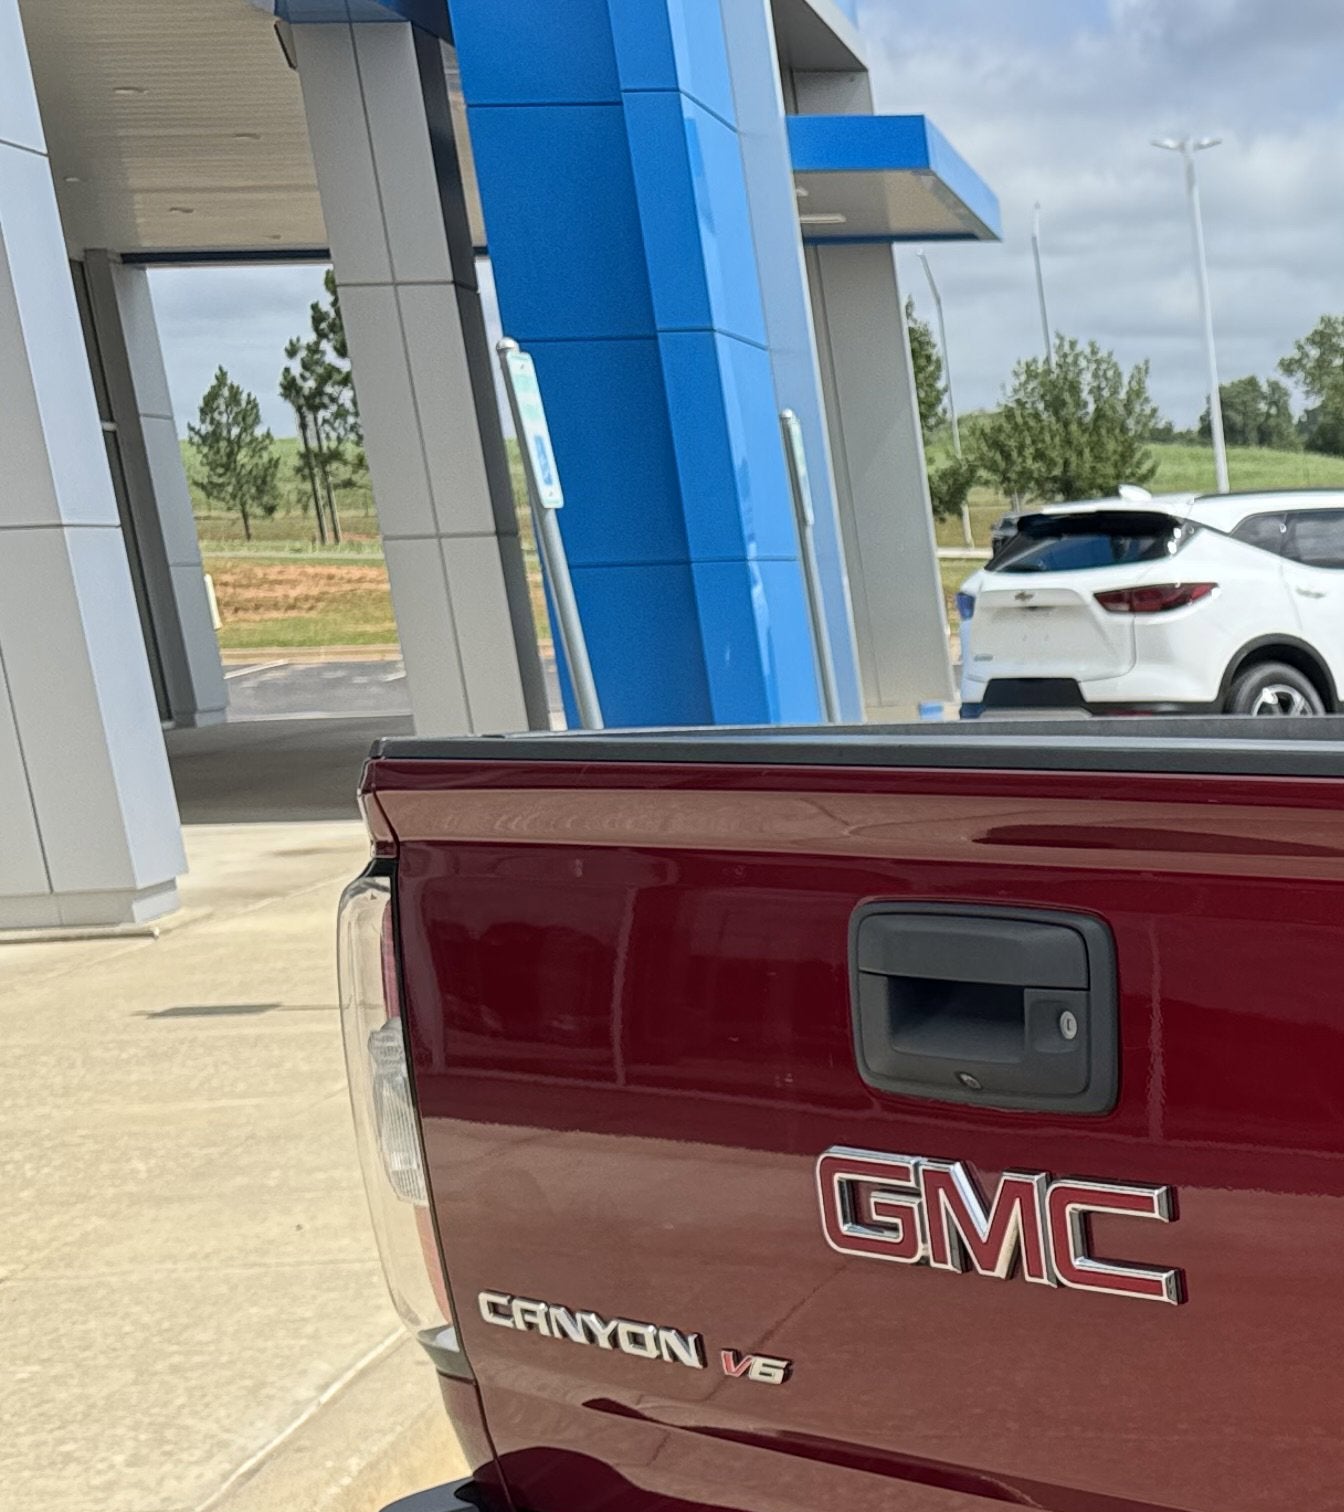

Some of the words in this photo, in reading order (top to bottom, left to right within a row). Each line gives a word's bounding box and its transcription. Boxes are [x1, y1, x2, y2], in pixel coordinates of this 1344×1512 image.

[816, 1146, 1188, 1305] GMC
[477, 1289, 706, 1371] CANYON
[720, 1349, 794, 1386] V6
